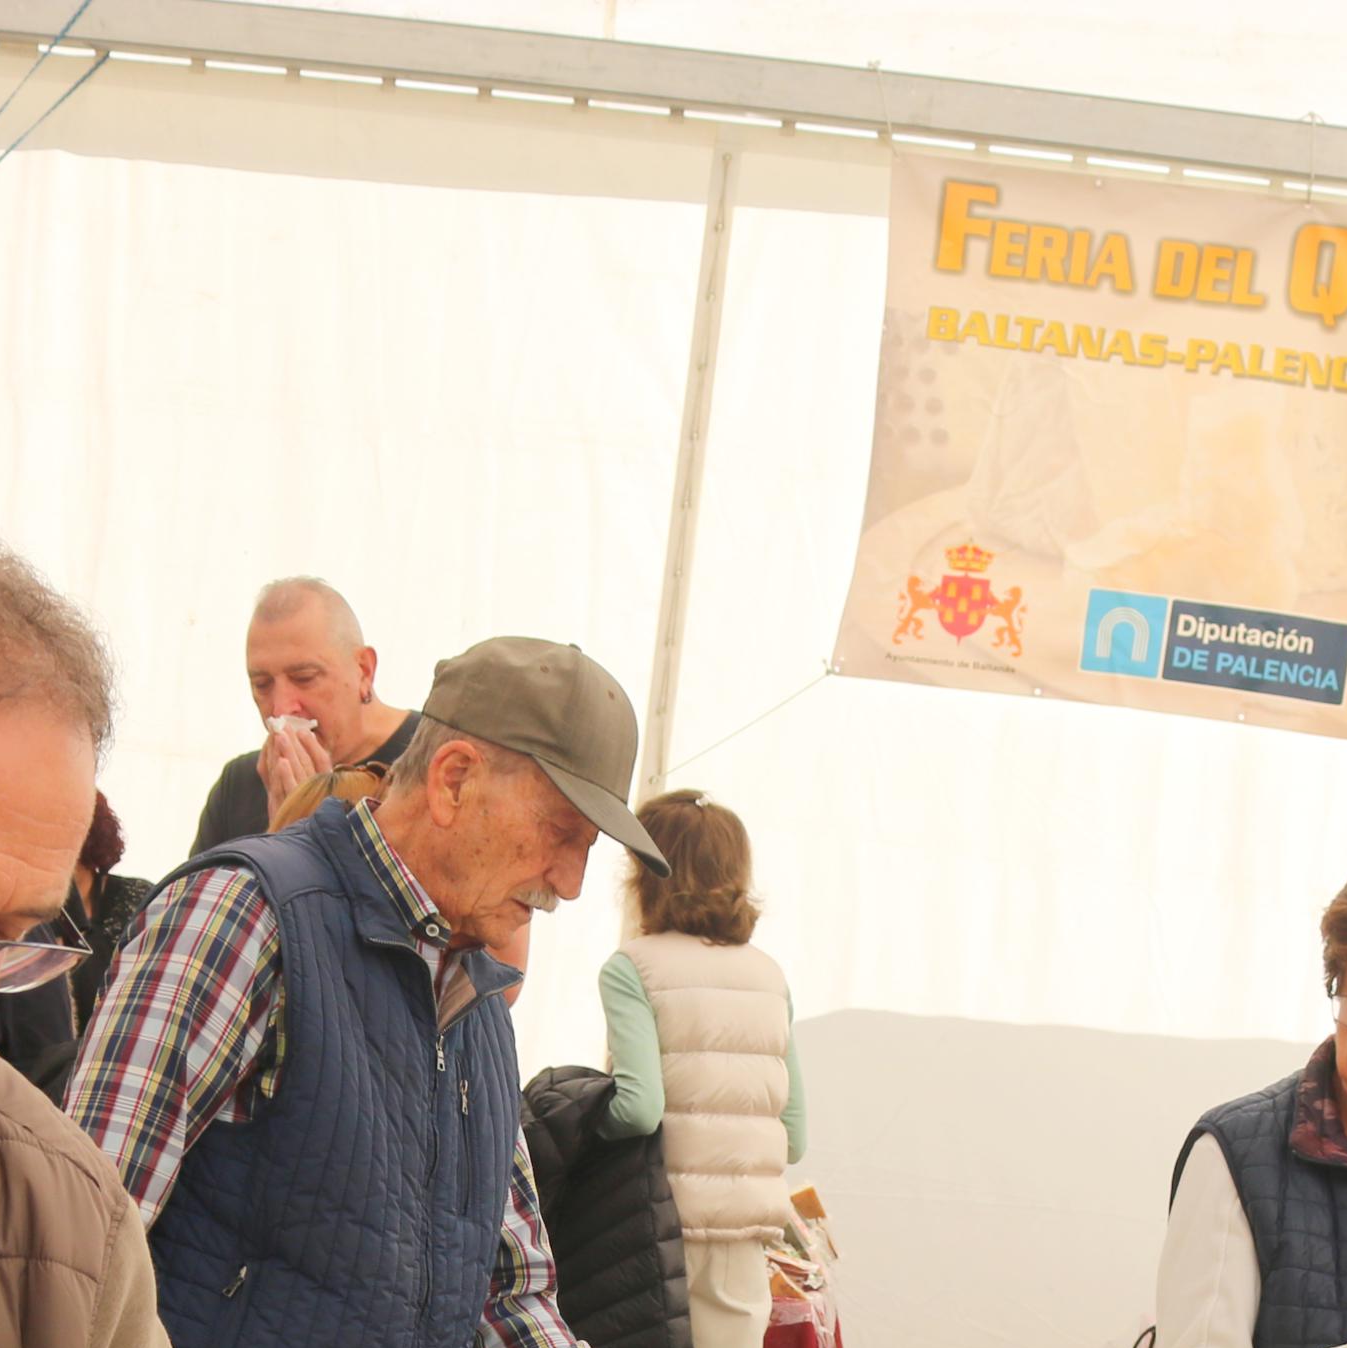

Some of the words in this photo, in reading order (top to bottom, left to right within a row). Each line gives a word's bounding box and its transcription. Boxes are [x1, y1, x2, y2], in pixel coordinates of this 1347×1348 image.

[1175, 612, 1316, 656] Diputación
[1171, 645, 1209, 673] DE
[1214, 653, 1340, 692] PALENCIA
